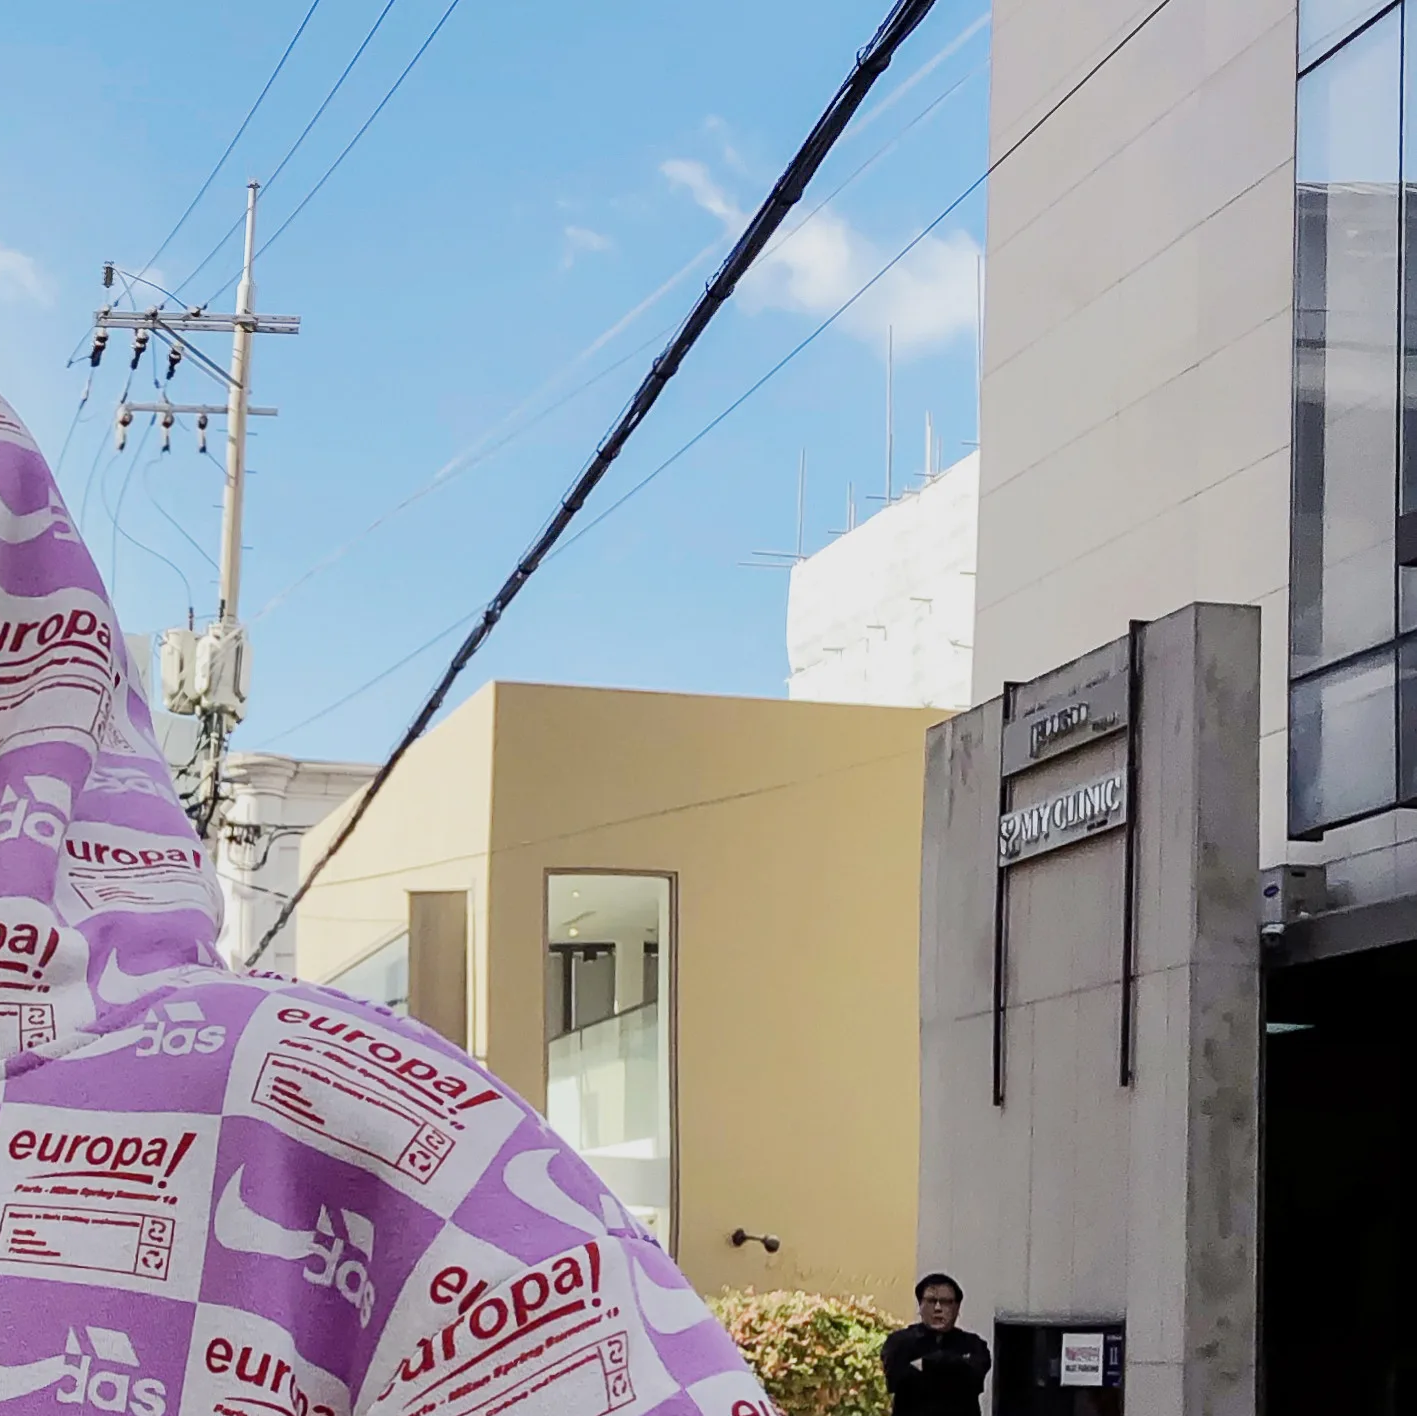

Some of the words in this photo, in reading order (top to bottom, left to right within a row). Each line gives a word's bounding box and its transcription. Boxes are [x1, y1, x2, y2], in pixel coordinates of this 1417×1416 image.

[135, 1021, 227, 1058] das
[276, 1006, 504, 1115] europa!
[8, 1130, 197, 1190] europa!
